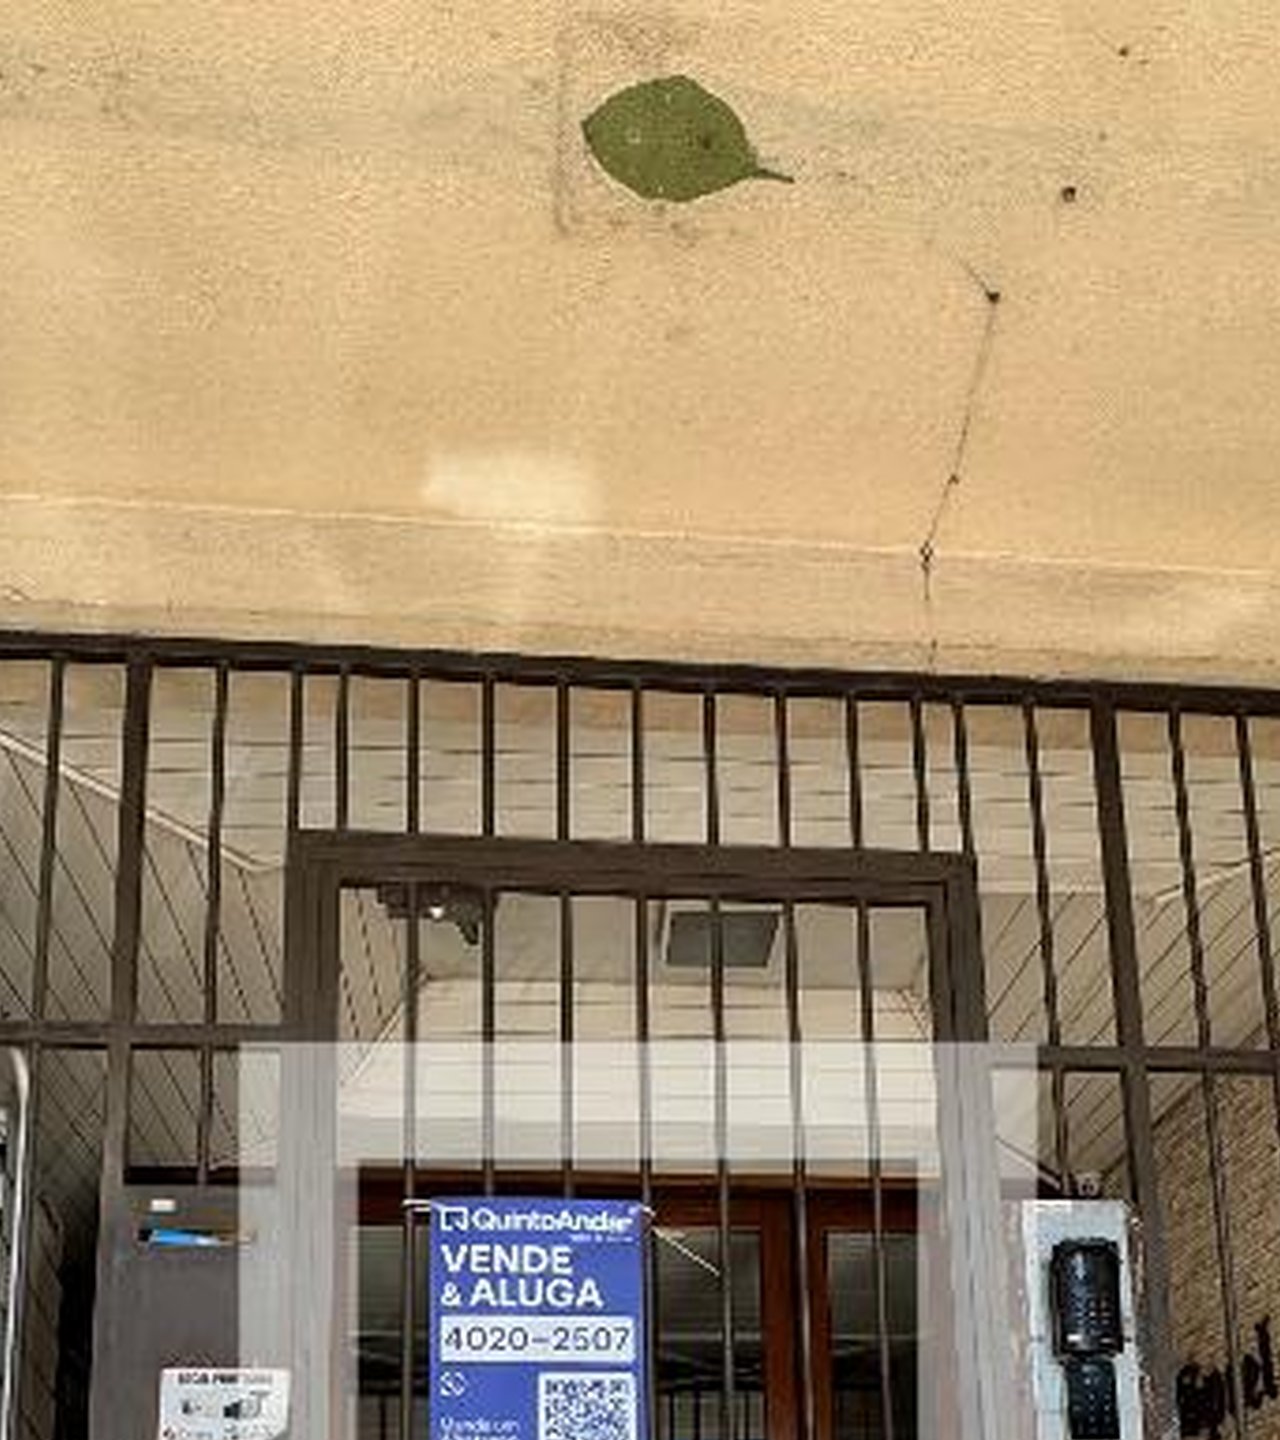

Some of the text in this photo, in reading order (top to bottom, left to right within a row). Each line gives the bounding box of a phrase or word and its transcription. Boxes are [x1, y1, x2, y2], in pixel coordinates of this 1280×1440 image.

[440, 1243, 574, 1275] VENDE
[440, 1278, 604, 1308] & ALUGA
[443, 1326, 631, 1352] 4020-2507
